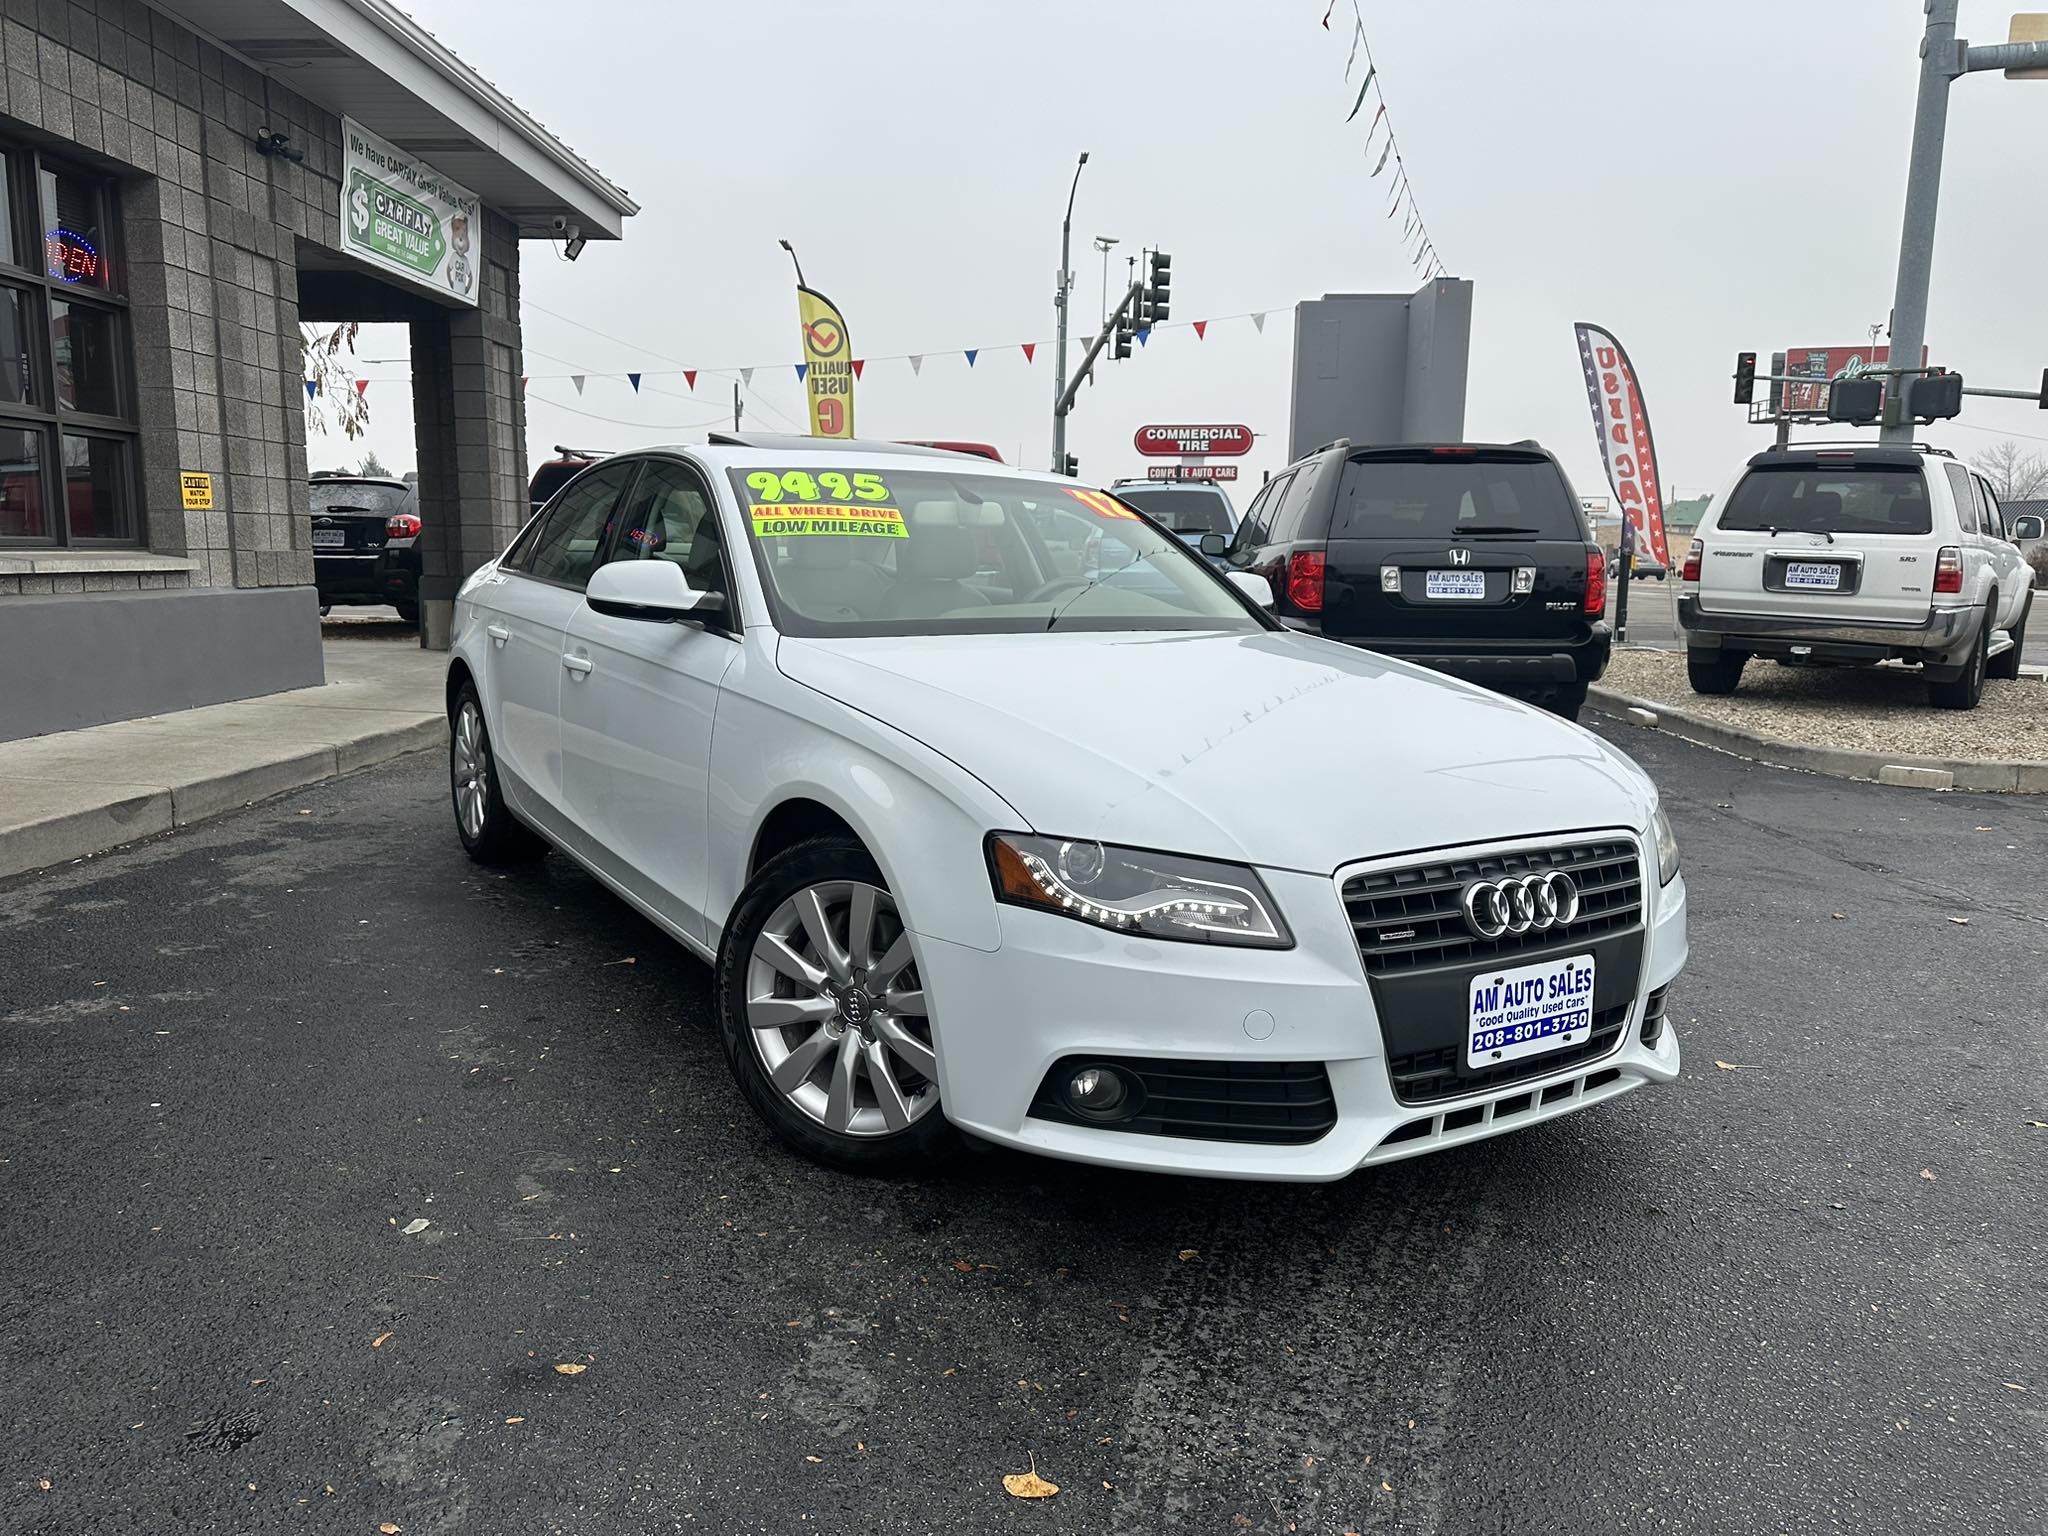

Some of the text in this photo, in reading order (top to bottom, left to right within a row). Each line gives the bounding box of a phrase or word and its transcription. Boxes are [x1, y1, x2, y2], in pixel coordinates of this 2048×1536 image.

[350, 133, 363, 155] We
[365, 143, 385, 168] have
[387, 156, 417, 187] CARFAX
[417, 174, 437, 197] Great
[375, 193, 433, 238] CARFAX
[375, 218, 403, 245] GREAT
[404, 231, 430, 257] VALUE
[1146, 428, 1242, 440] COMMERCIAL
[1177, 440, 1210, 451] TIRE
[1149, 467, 1236, 478] COMPLTE AUTO CARE
[746, 471, 890, 502] 9495
[753, 506, 899, 519] ALL WHEEL DRIVE
[763, 520, 899, 534] LOW MILEAGE
[1428, 574, 1483, 582] AM AUTO SALES
[1800, 566, 1818, 574] AUTO
[1819, 567, 1840, 575] SALES
[1473, 967, 1592, 1015] AM AUTO SALES
[1506, 1006, 1540, 1023] Quality
[1542, 1000, 1563, 1014] Used
[1474, 1011, 1588, 1051] 208-801-3750
